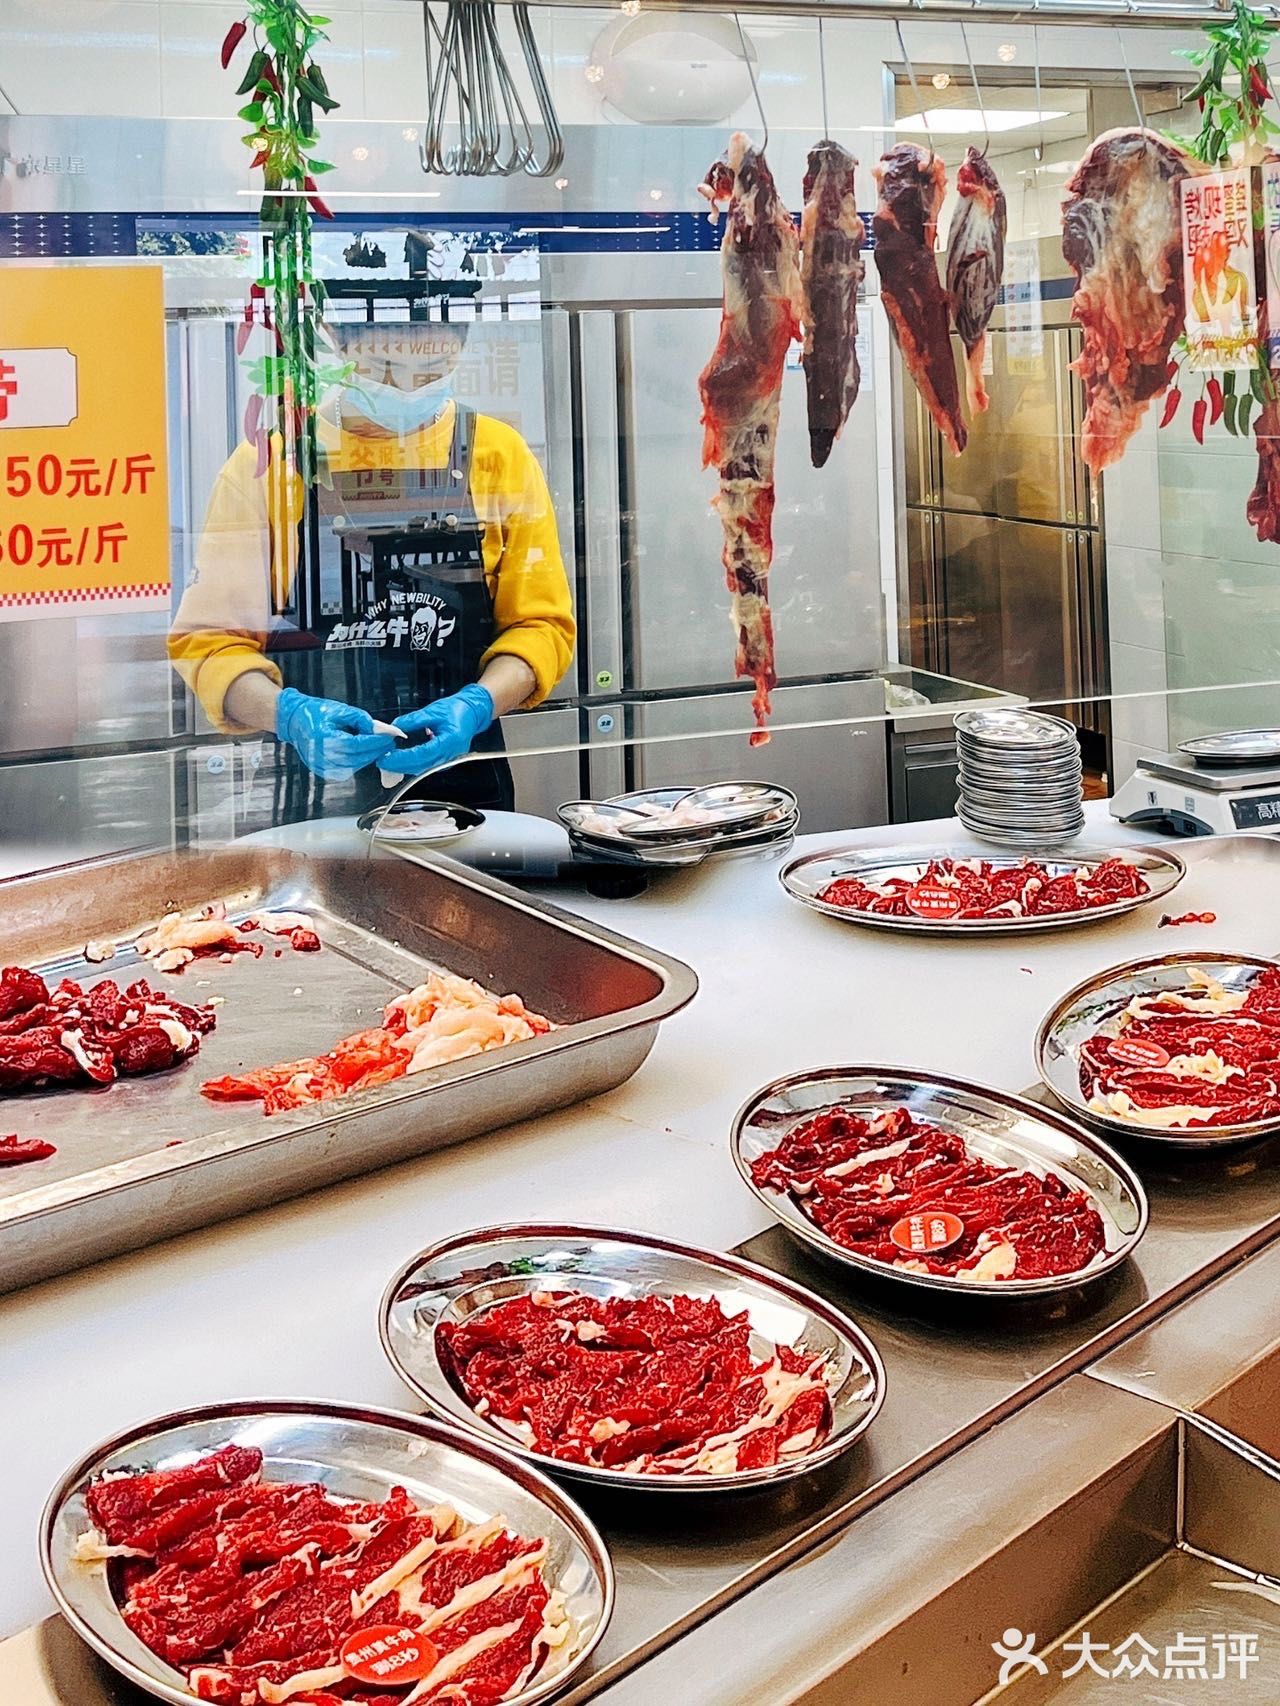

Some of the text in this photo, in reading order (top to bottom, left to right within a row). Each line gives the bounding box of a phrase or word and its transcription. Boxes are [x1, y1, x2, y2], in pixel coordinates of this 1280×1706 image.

[410, 340, 481, 355] WELCOME
[6, 453, 155, 498] 50元/斤
[0, 522, 128, 568] 0元/斤
[365, 592, 447, 620] WHY NEWBILITY
[344, 1628, 416, 1667] 贵州黄牛肉
